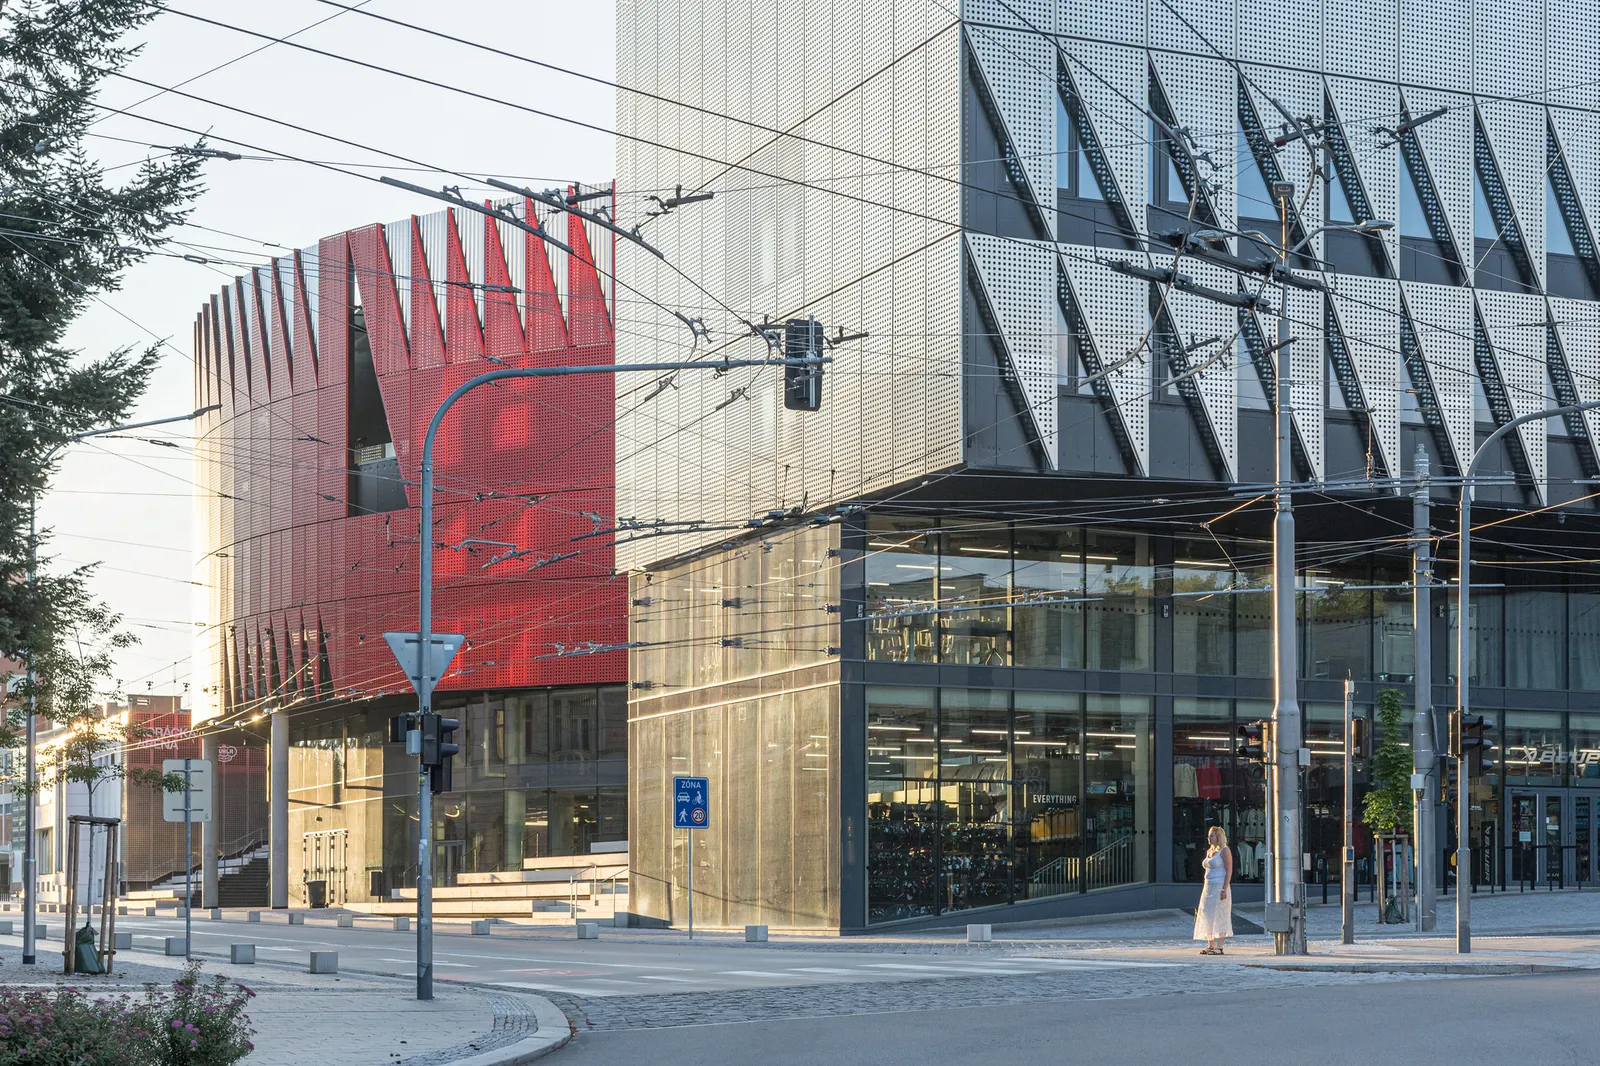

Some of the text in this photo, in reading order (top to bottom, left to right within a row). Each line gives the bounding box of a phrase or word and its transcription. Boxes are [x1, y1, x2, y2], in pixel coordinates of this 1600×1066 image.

[138, 725, 197, 738] ORÁCK
[681, 780, 701, 789] ZÓNA
[1033, 794, 1077, 804] EVERYTHING
[694, 812, 703, 820] 20
